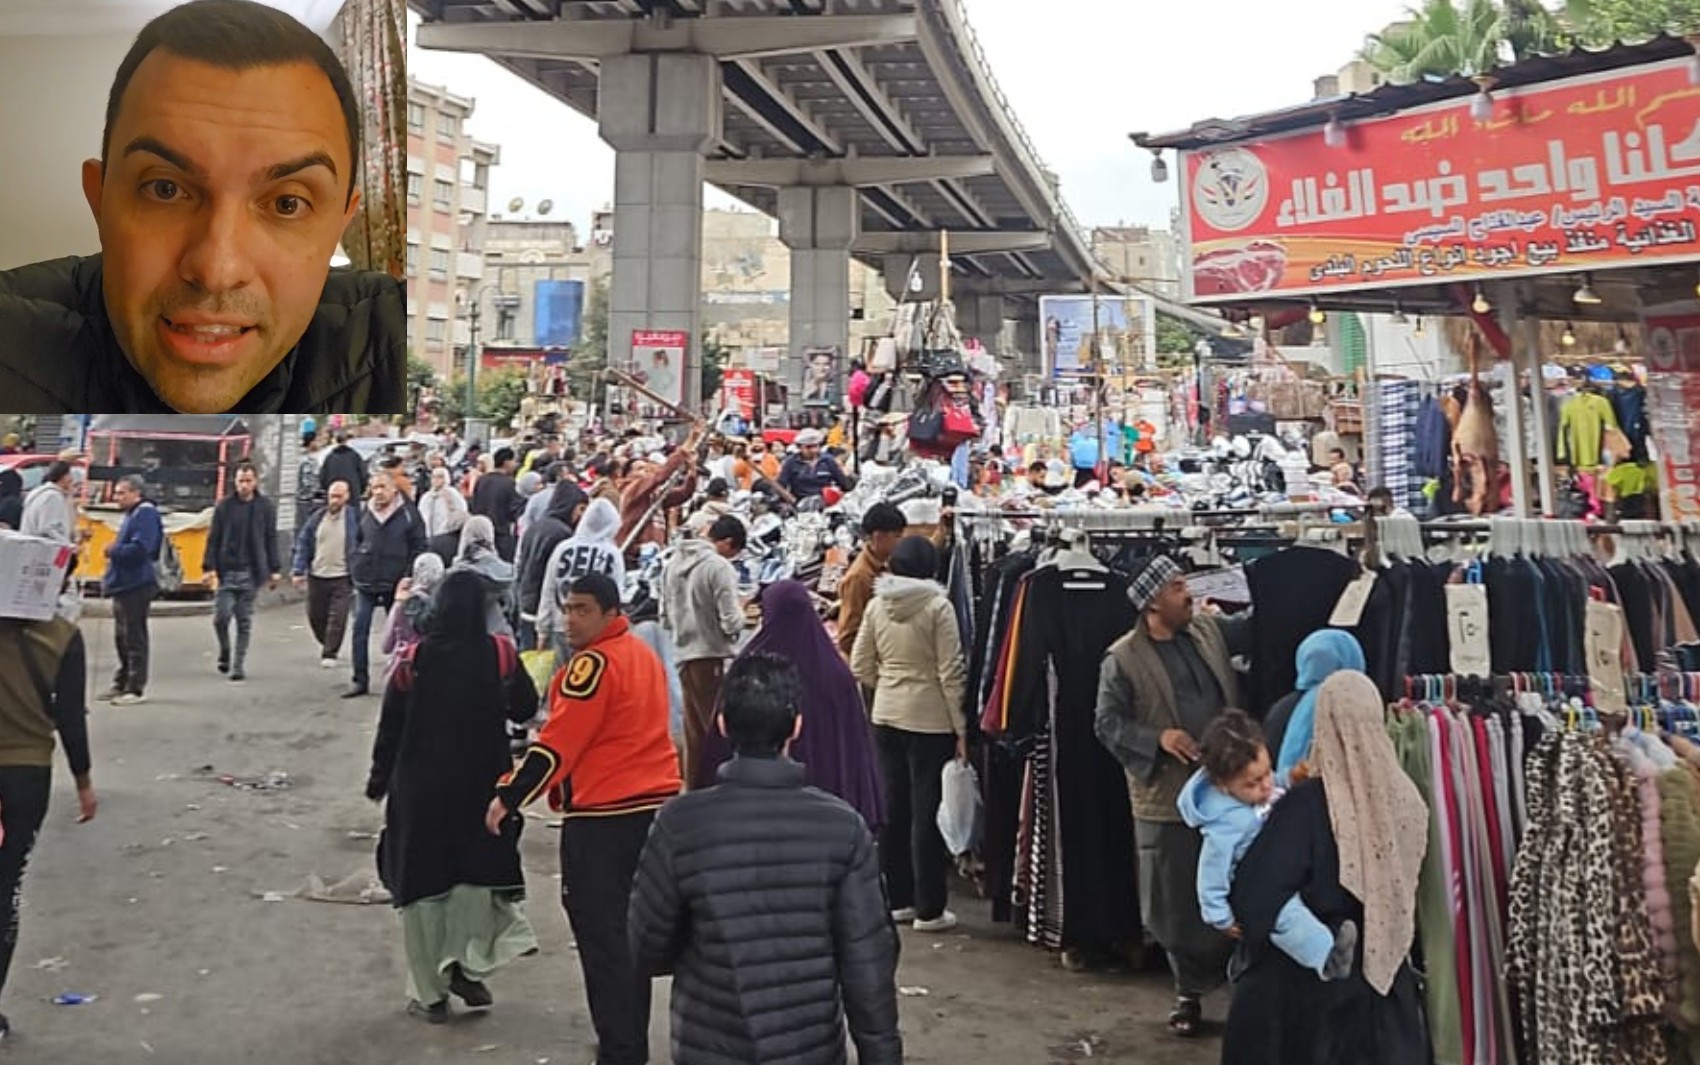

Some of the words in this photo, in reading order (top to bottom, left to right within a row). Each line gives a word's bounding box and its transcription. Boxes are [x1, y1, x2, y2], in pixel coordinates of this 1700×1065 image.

[1566, 84, 1636, 115] الله
[1400, 114, 1460, 142] الله
[1602, 117, 1700, 185] كلنا
[1477, 139, 1601, 202] واحد
[1276, 168, 1377, 228] الغلاء
[1382, 160, 1469, 217] ضد
[1630, 189, 1685, 220] السيد
[1527, 241, 1559, 267] بيع
[1565, 229, 1609, 254] منفذ
[1361, 248, 1413, 280] اللحوم
[569, 656, 594, 686] 9
